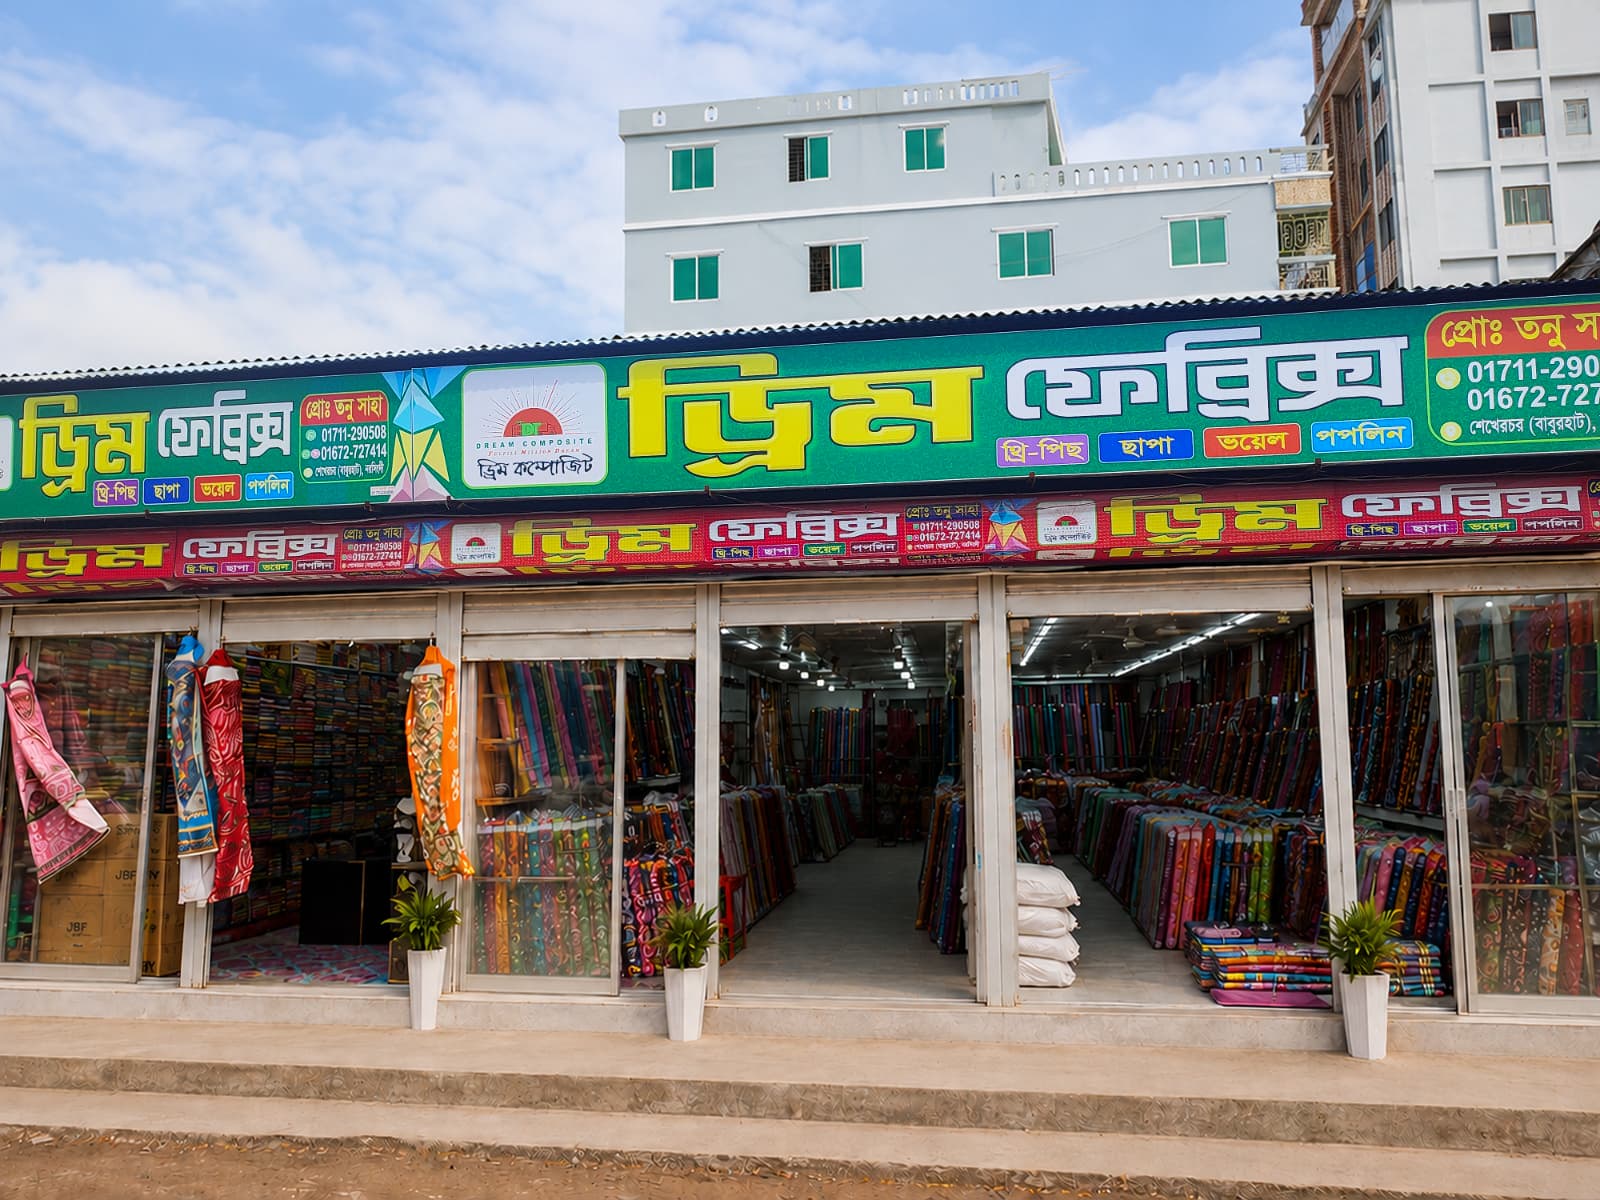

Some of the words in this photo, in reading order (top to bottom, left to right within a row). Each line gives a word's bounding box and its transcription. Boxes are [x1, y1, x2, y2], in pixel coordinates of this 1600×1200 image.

[1512, 314, 1566, 350] তনু
[333, 398, 355, 422] তনু
[357, 395, 384, 418] সাহা
[616, 352, 985, 478] ড্রিম
[321, 425, 387, 442] 01711-290508
[476, 441, 514, 449] DREAM
[522, 438, 592, 447] COMPOSITE
[1316, 421, 1408, 447] পপলিন
[18, 394, 151, 497] ড্রিম
[320, 443, 387, 460] 01672-727414
[1118, 435, 1175, 458] ছাপা
[153, 483, 180, 500] ছাপা
[248, 474, 290, 495] পপলিন
[919, 520, 980, 531] 01711-290508
[919, 531, 981, 542] 01672-727414
